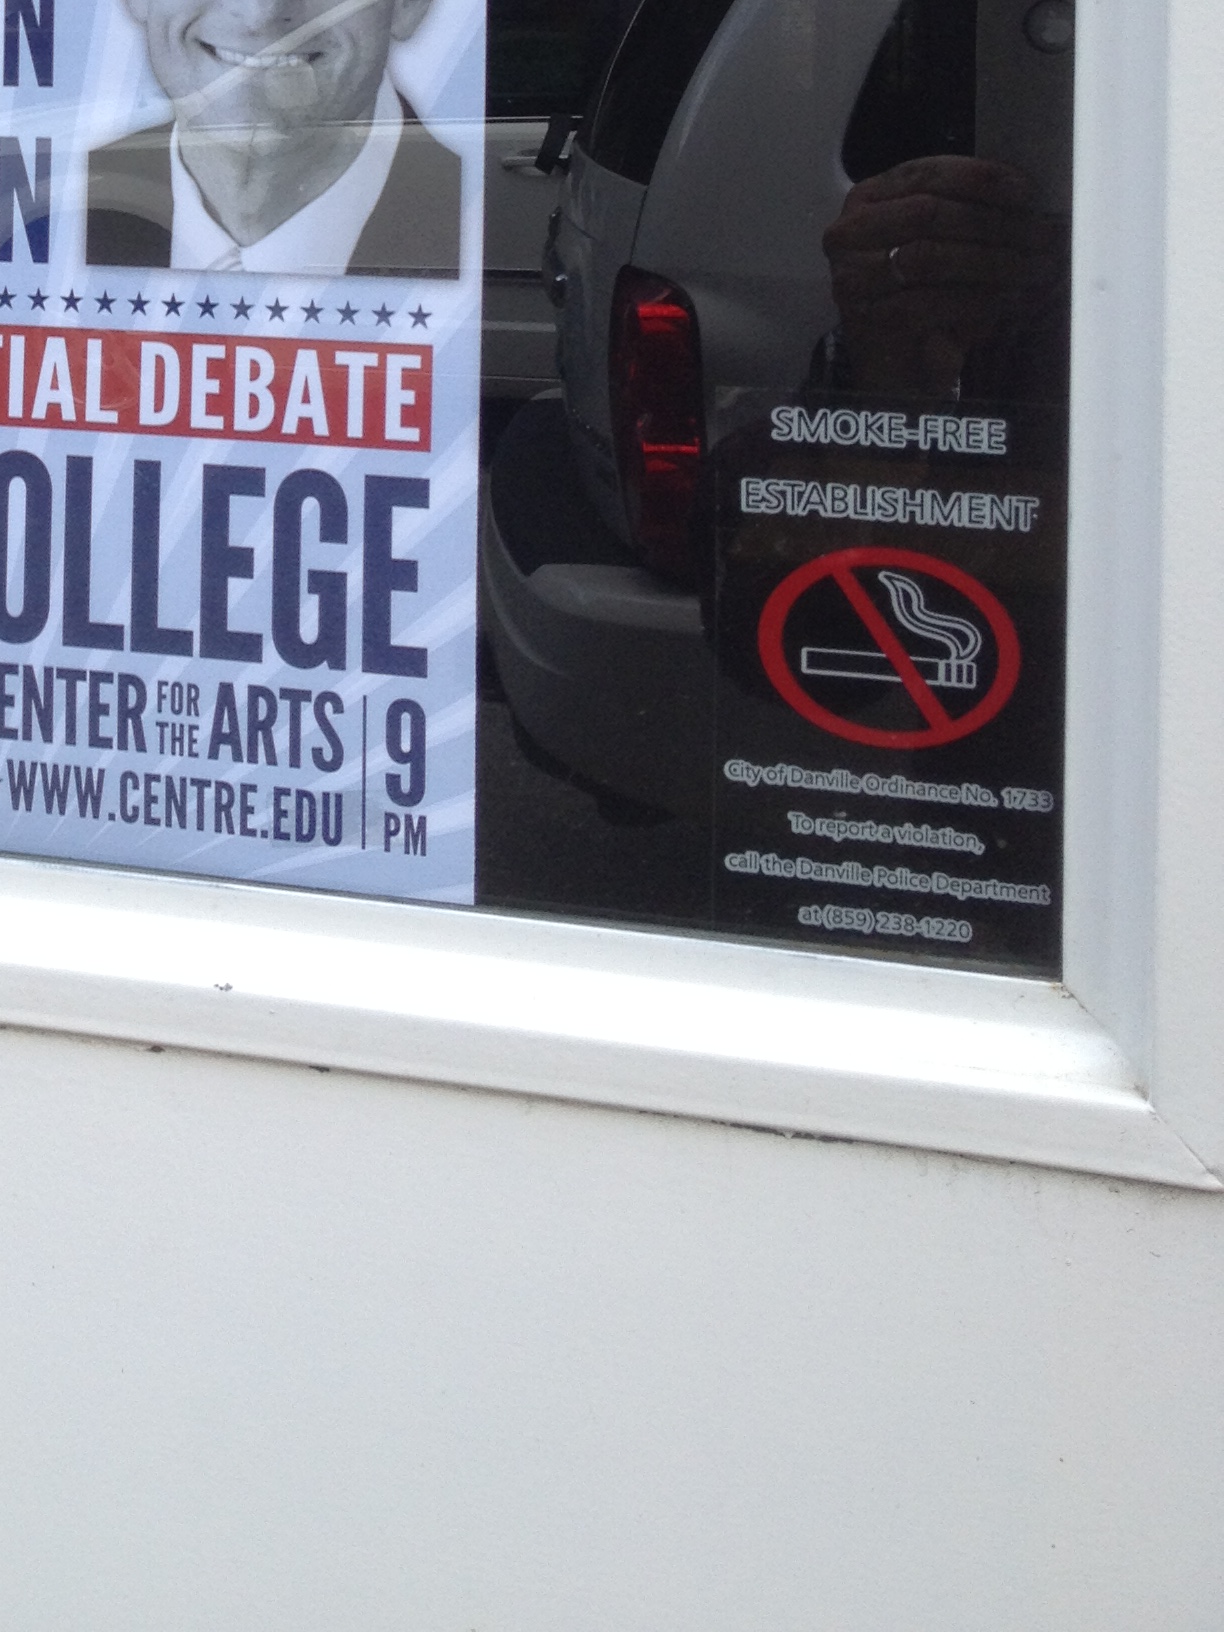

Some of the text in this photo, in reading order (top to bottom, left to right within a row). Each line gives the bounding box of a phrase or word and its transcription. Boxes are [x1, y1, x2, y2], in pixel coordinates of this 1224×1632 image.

[139, 340, 422, 443] DEBATE
[770, 405, 1007, 455] SMOKE-FREE
[740, 477, 1039, 532] ESTABLISHMENT
[157, 680, 200, 717] FOR
[155, 721, 200, 759] THE
[207, 681, 345, 773] ARTS
[384, 697, 427, 808] 9
[6, 758, 343, 847] WWW.CENTRE.EDU
[725, 760, 1054, 813] City of Danville Ordinance No. 1733
[383, 811, 427, 857] PM
[788, 811, 986, 855] To report a violation,
[725, 851, 1051, 905] call the Danville Police Department
[798, 904, 973, 943] at (859) 238-1220
